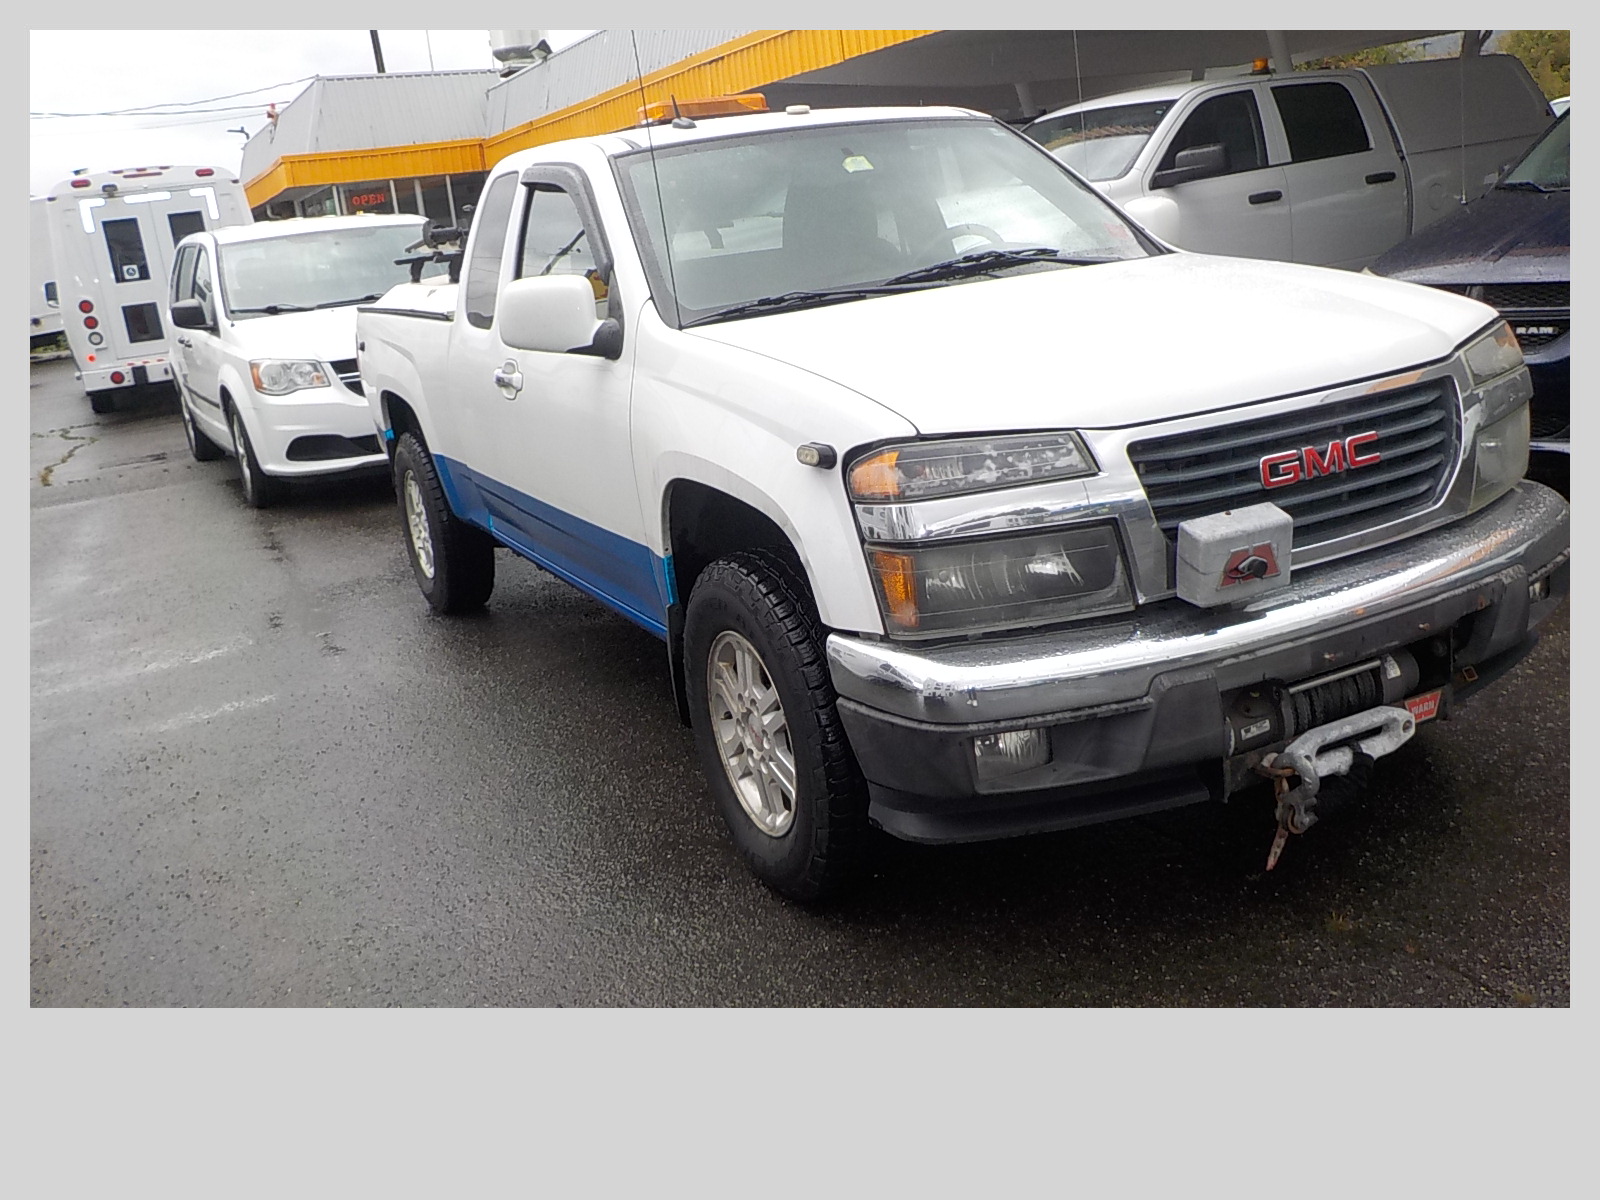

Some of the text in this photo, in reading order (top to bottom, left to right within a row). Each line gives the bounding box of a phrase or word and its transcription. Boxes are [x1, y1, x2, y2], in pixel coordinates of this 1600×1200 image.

[352, 193, 385, 205] OPEN
[1515, 326, 1554, 335] RAM
[1260, 431, 1381, 489] GMC
[1411, 700, 1435, 715] WARN
